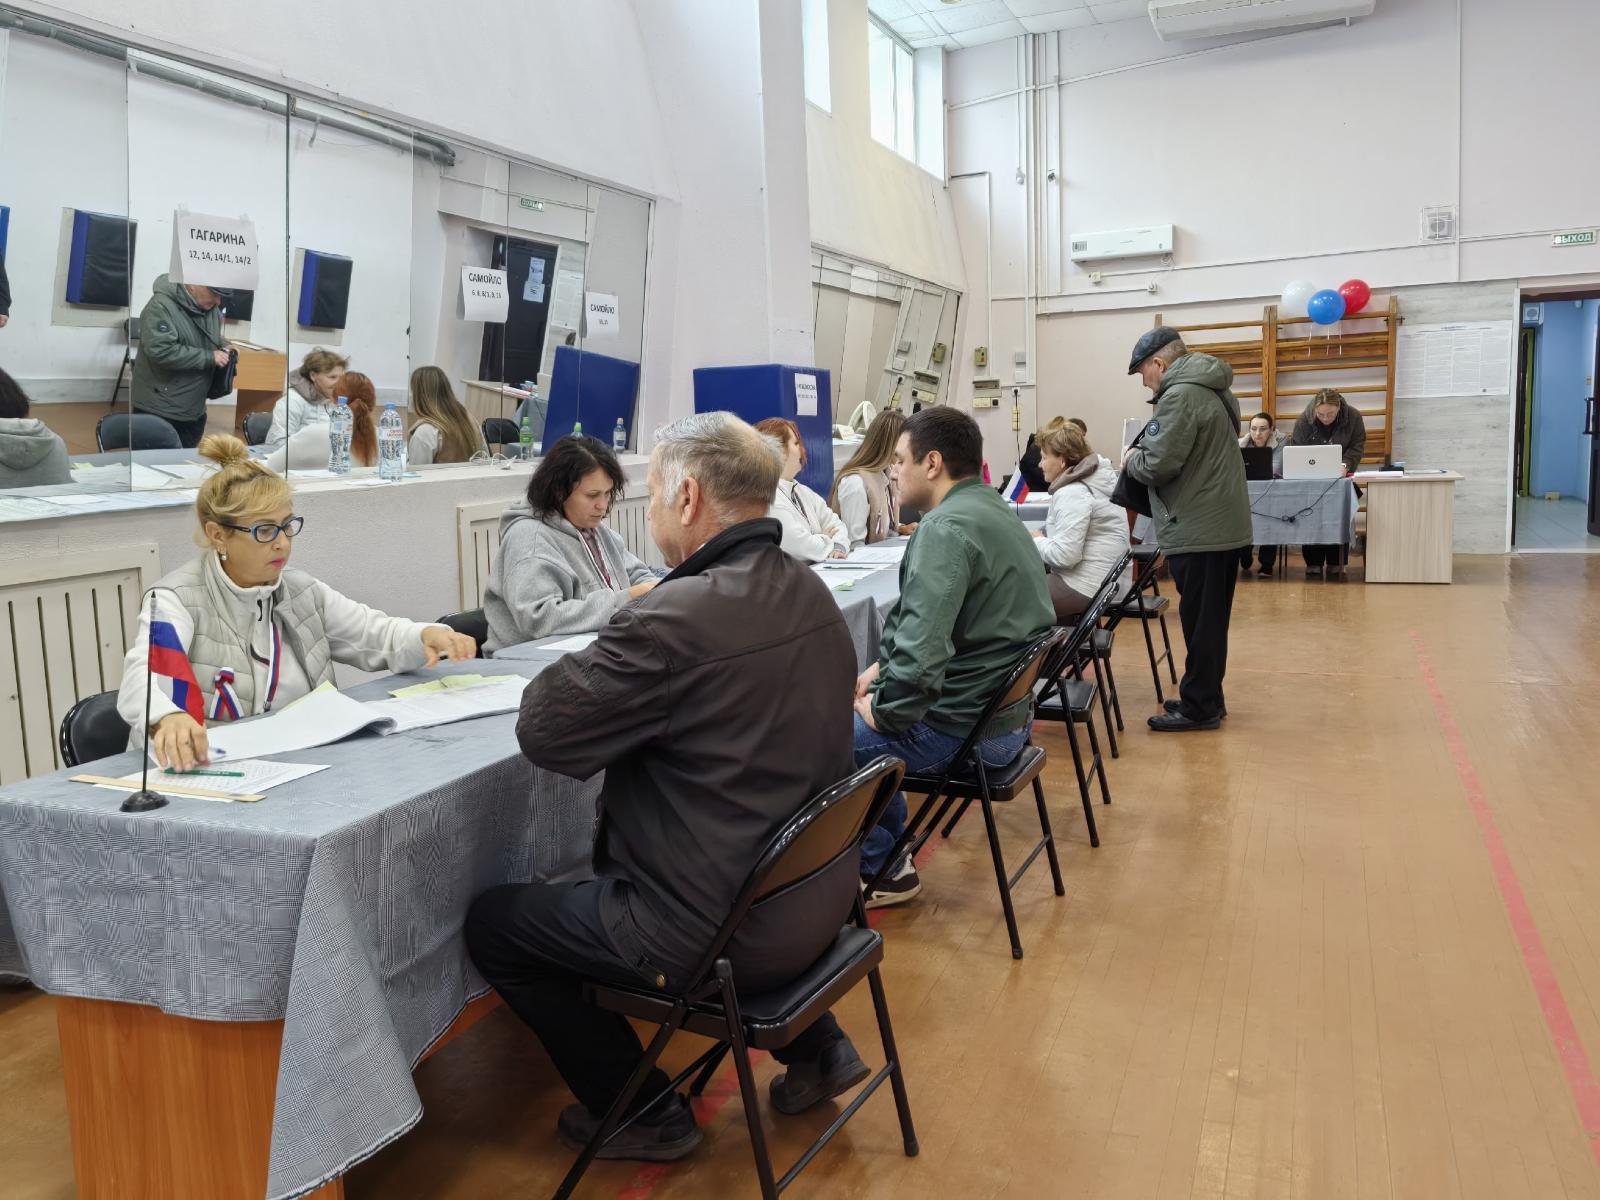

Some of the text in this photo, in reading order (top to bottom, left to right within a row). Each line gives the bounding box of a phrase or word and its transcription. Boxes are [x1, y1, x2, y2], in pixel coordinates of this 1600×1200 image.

[190, 228, 246, 246] ГАГАРИНА
[189, 250, 200, 260] 12,
[201, 251, 213, 262] 14,
[235, 255, 252, 266] 14/2
[468, 272, 502, 285] САМОЙЛО
